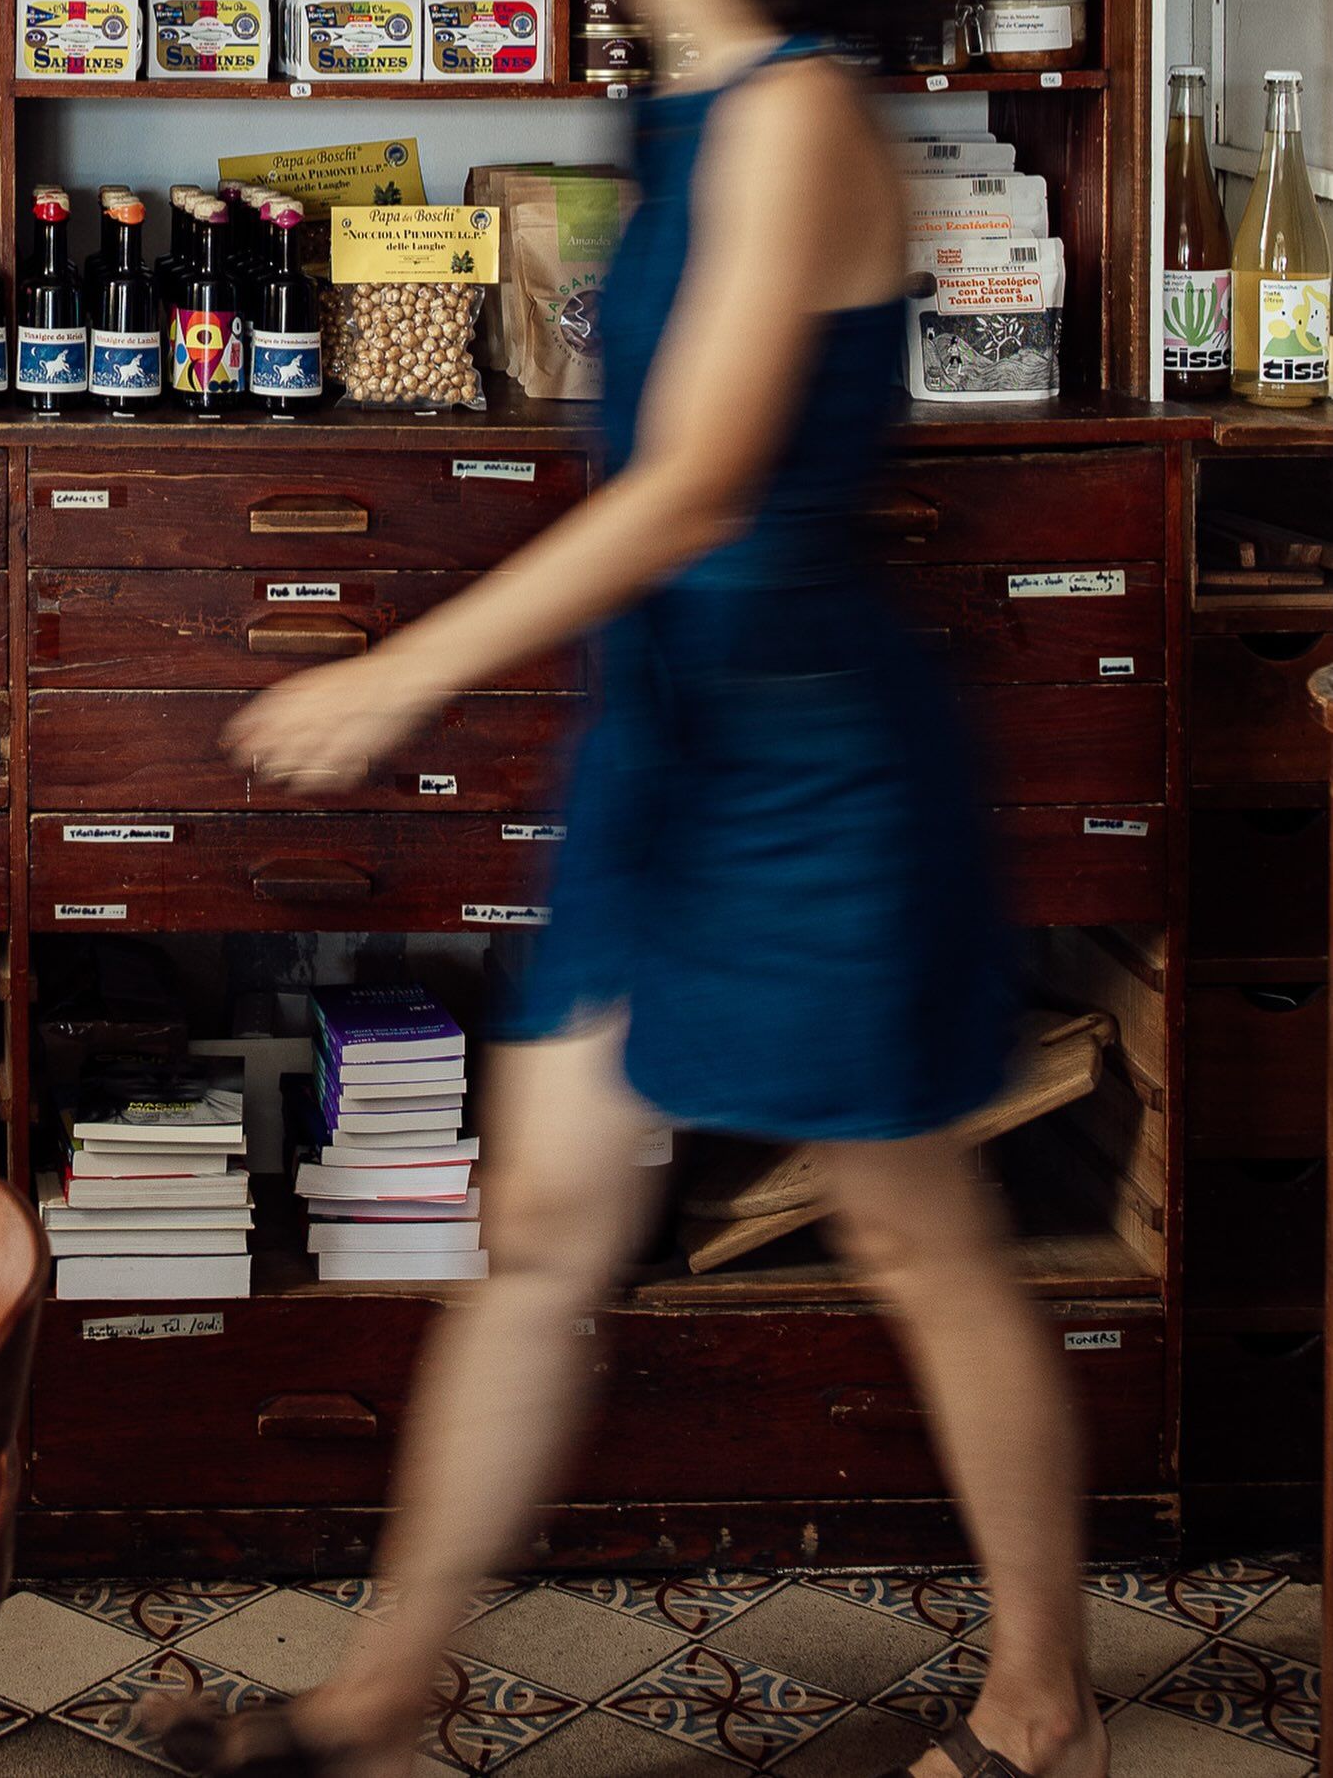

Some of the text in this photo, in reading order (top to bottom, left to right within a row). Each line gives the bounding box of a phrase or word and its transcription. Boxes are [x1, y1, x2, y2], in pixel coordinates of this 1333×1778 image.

[33, 47, 124, 70] SARDINES
[166, 47, 255, 69] SARDINES
[318, 47, 408, 69] SARDINES
[442, 48, 532, 70] SARDINES
[272, 153, 303, 170] Papa
[317, 148, 359, 165] Boschi
[308, 165, 358, 181] PIEMONTE
[293, 179, 351, 192] delle Langhe
[369, 209, 400, 225] Papa
[415, 208, 456, 223] Boschi
[402, 229, 456, 240] PIEMONTE
[385, 241, 446, 252] delle Langhe
[939, 275, 1040, 289] Pistacho Ecológico
[979, 285, 1022, 296] Cáscara
[947, 293, 1034, 305] Tostado con Sal
[1263, 296, 1284, 304] citron
[127, 1319, 154, 1336] vides
[1067, 1332, 1117, 1345] TONERS
